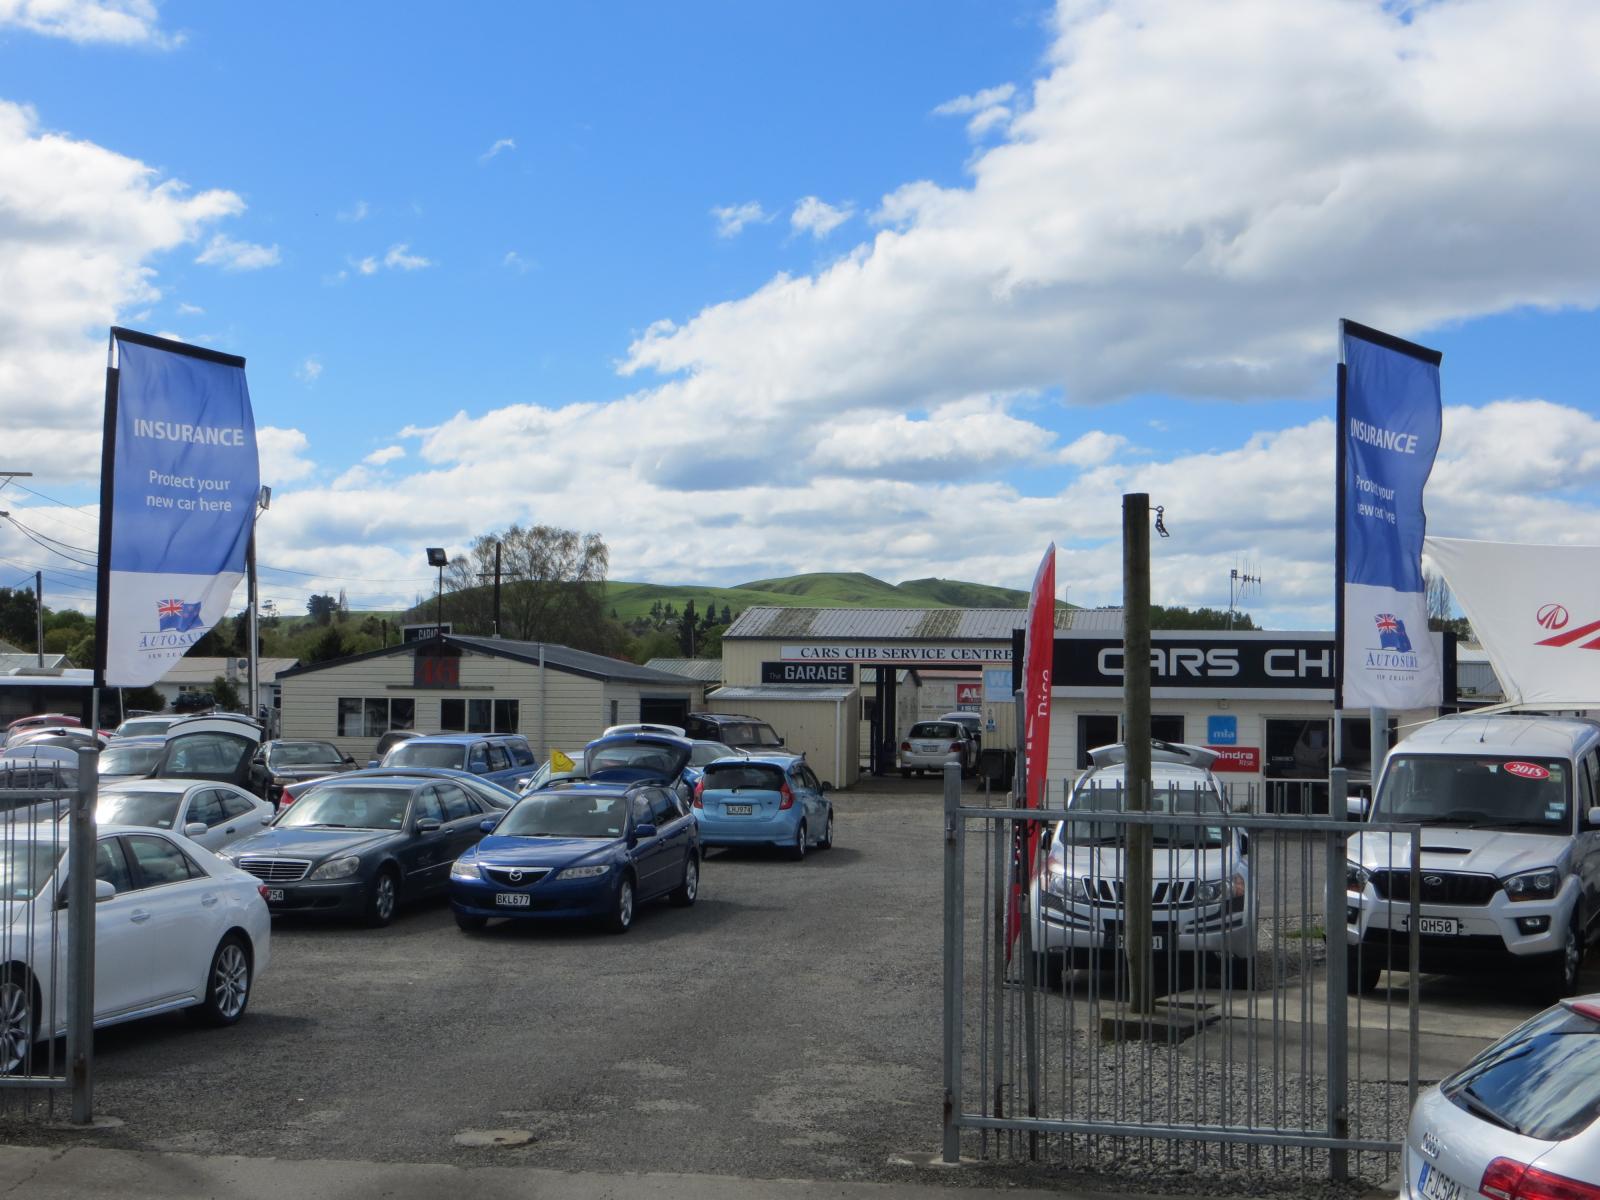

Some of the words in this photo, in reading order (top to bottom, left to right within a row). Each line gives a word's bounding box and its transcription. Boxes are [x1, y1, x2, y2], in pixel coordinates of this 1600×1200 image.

[133, 418, 245, 447] INSURANCE
[1350, 417, 1419, 455] INSURANCE
[148, 469, 195, 490] Protect
[197, 478, 231, 495] your
[146, 494, 174, 510] new
[177, 497, 195, 512] car
[199, 496, 232, 512] here
[800, 646, 840, 659] CARS
[844, 647, 877, 659] CHB
[882, 647, 946, 659] SERVICE
[951, 648, 1013, 660] CENTRE
[1097, 647, 1240, 678] CARS
[1263, 649, 1335, 679] CH
[784, 665, 847, 680] GARAGE
[497, 894, 530, 905] BKL677
